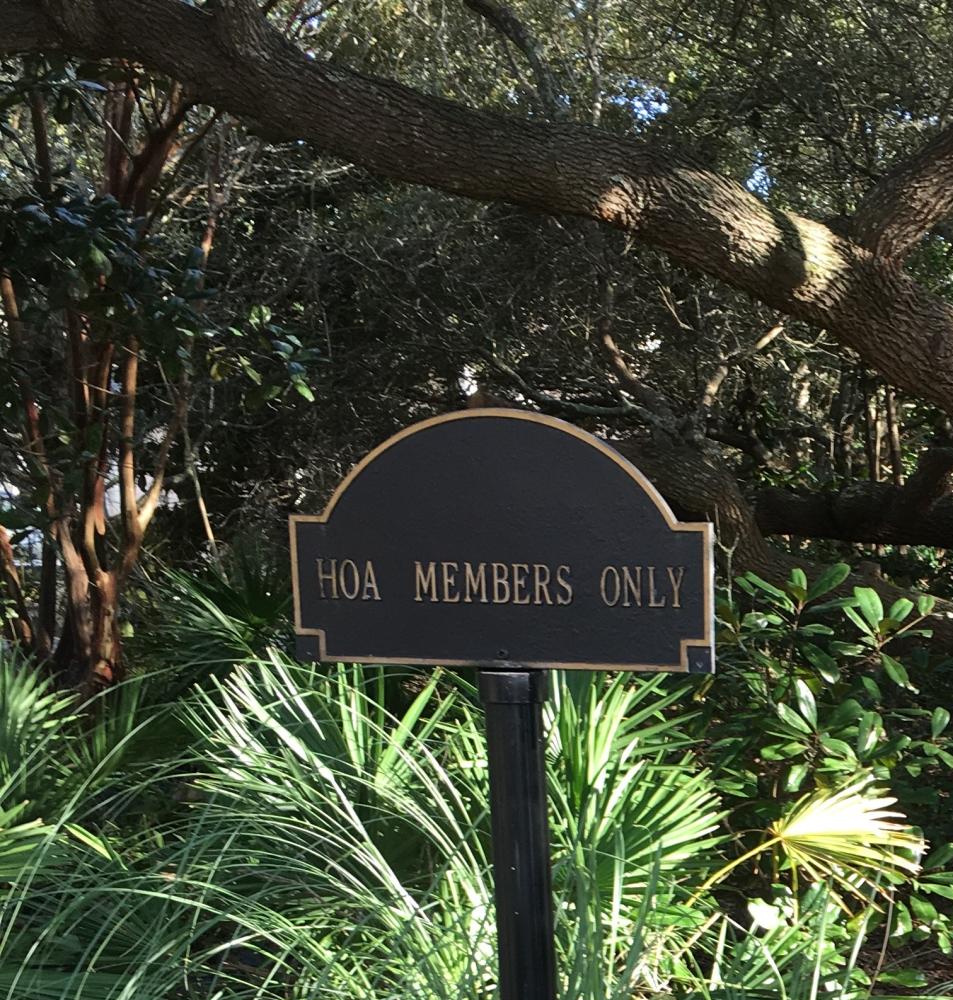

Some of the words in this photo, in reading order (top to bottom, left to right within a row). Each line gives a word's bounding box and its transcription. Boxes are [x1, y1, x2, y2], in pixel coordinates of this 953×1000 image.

[316, 558, 382, 601] HOA
[413, 561, 574, 606] MEMBERS
[600, 566, 686, 608] ONLY
